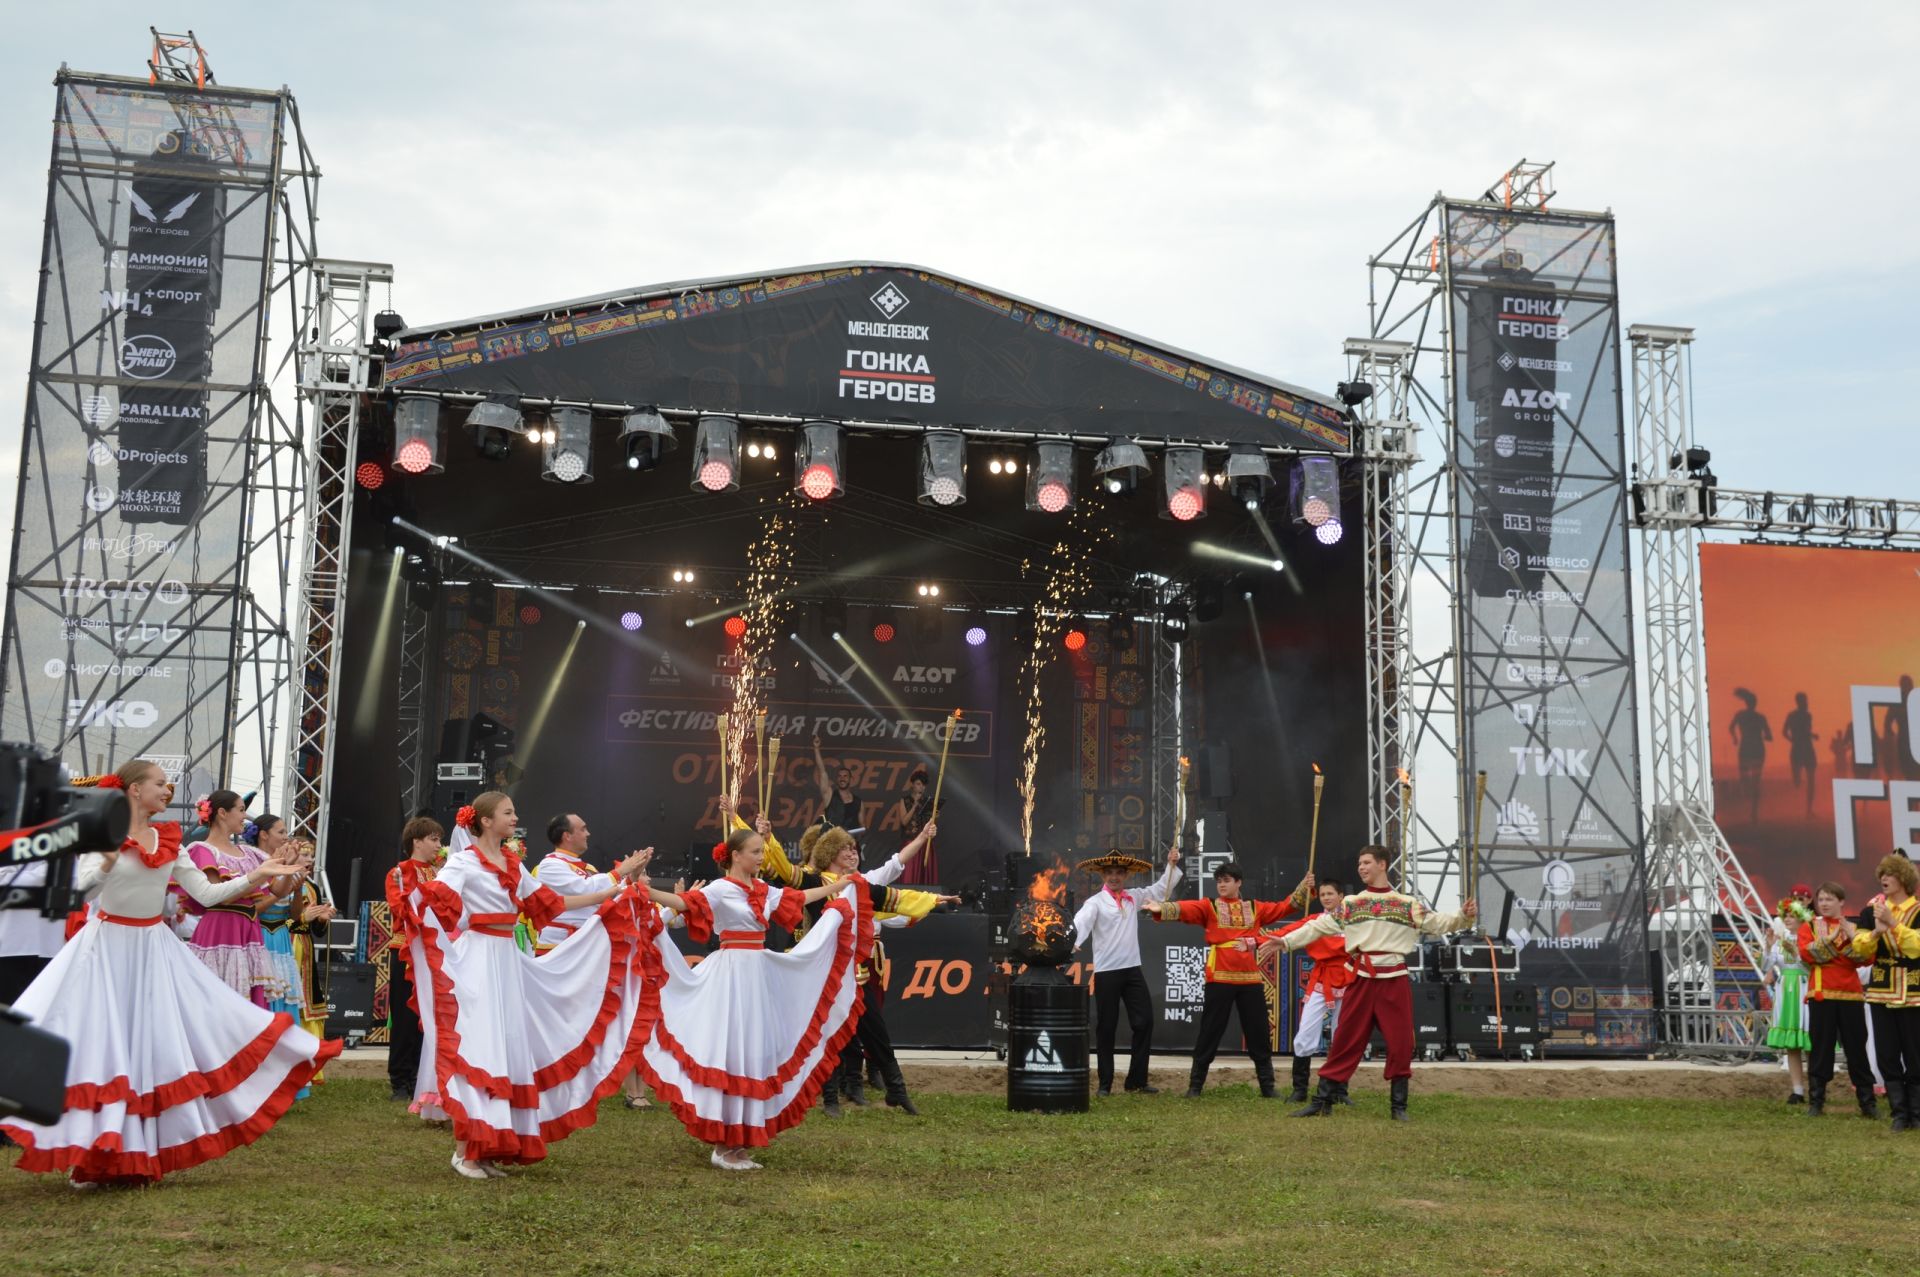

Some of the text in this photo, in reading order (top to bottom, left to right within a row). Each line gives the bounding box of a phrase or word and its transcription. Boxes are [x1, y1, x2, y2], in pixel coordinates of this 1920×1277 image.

[155, 227, 190, 236] ГЕРОЕВ
[128, 252, 209, 268] АММОНИЙ
[1502, 297, 1566, 315] ГОНКА
[848, 320, 930, 341] МЕНДЕЛЕЕВСК
[1498, 320, 1570, 340] ГЕРОЕВ
[136, 357, 168, 368] МАШ
[846, 349, 931, 374] ГОНКА
[838, 378, 936, 404] ГЕРОЕВ
[1501, 388, 1571, 410] AZOT
[119, 402, 201, 418] PARALLAX
[1514, 412, 1560, 422] GROUP
[119, 450, 188, 465] DProjects
[120, 489, 182, 506] 冰轮环境
[1541, 489, 1550, 498] &
[119, 504, 180, 514] MOON-TECH
[1526, 555, 1590, 569] ИНВЕНСО
[61, 617, 111, 630] Ак Барс
[60, 630, 90, 641] Банк
[70, 663, 172, 678] ЧИСТОПОЛЬЕ
[892, 665, 957, 684] AZOT
[904, 686, 945, 695] GROUP
[618, 708, 806, 736] ФЕСТИВНАЯ
[812, 716, 887, 737] ГОНКА
[672, 752, 725, 785] ОТ
[1509, 746, 1591, 777] ТИК
[12, 822, 80, 861] RONIN
